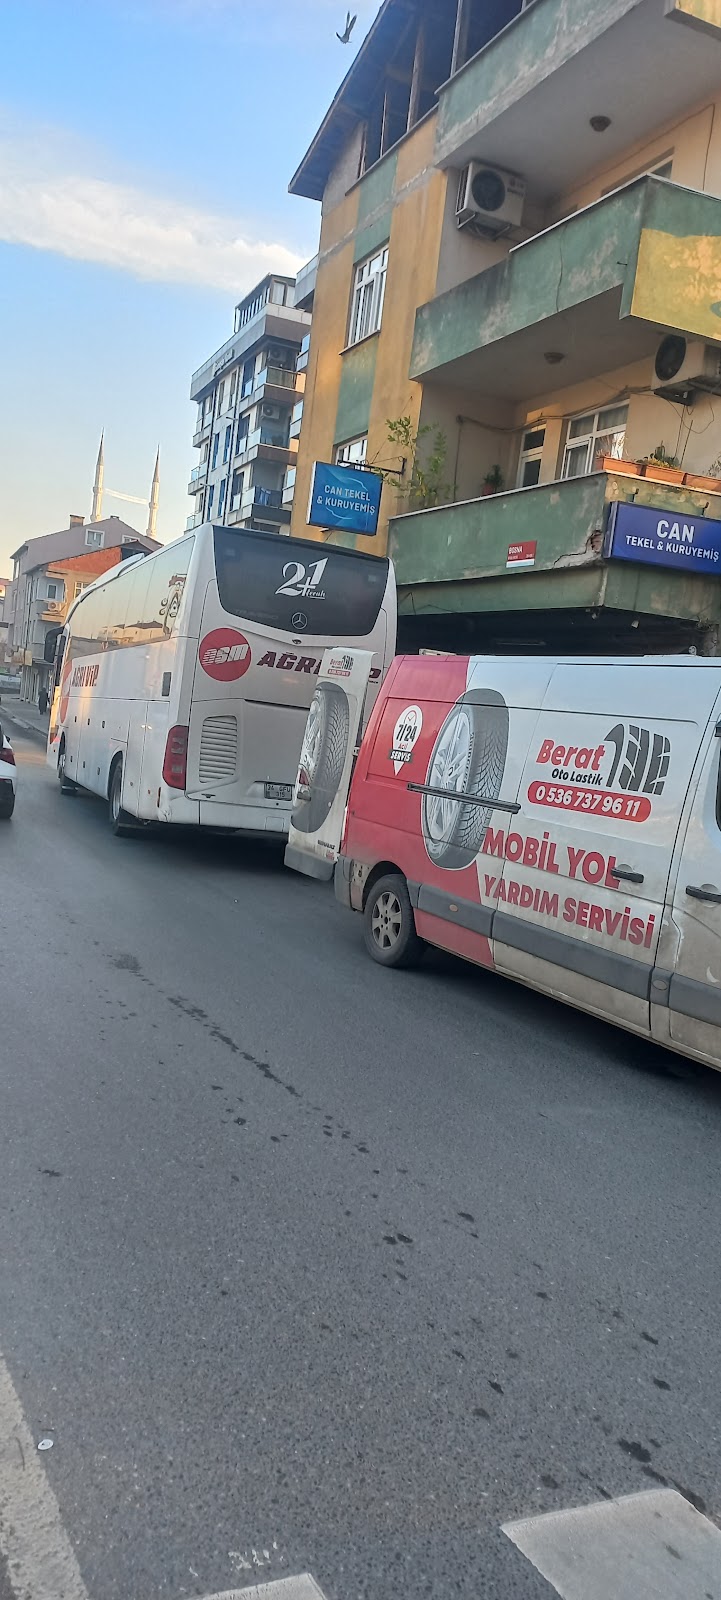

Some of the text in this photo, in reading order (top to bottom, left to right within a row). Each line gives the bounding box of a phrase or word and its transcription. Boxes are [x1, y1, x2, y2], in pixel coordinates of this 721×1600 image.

[317, 496, 376, 515] & KURUYEMİŞ
[324, 485, 371, 501] CAN TEKEL
[656, 519, 695, 543] CAN
[625, 535, 720, 562] TEKEL & KURUYEMİŞ
[396, 724, 417, 742] 7/24
[536, 739, 605, 771] Berat
[551, 768, 603, 786] Oto Lastik
[535, 785, 641, 817] 0 536 737 96 11
[482, 827, 621, 889] MOBİL YOL
[483, 874, 656, 949] YARDIM SERVİSİ
